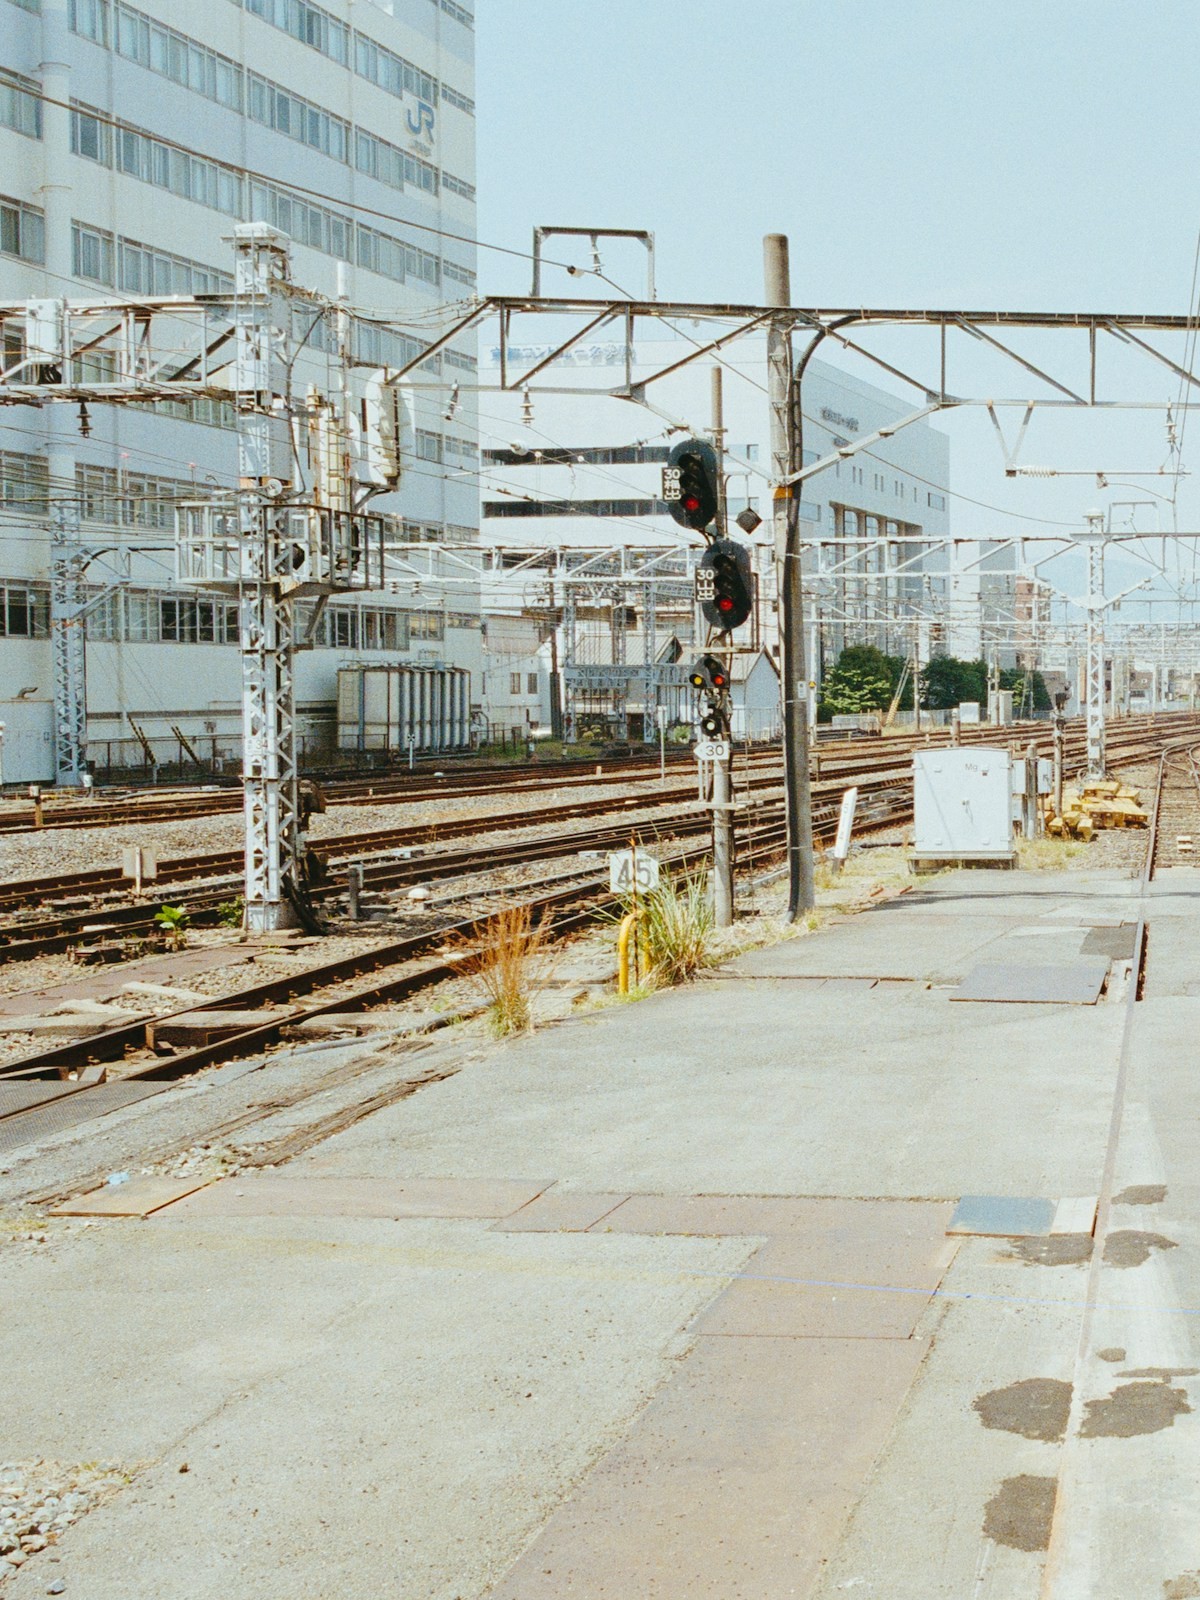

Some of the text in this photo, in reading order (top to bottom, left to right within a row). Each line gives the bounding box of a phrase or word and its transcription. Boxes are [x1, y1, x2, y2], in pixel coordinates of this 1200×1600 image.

[407, 99, 435, 145] JR
[664, 469, 681, 480] 30
[697, 569, 715, 580] 30
[705, 745, 725, 757] 30
[617, 858, 652, 888] 45
